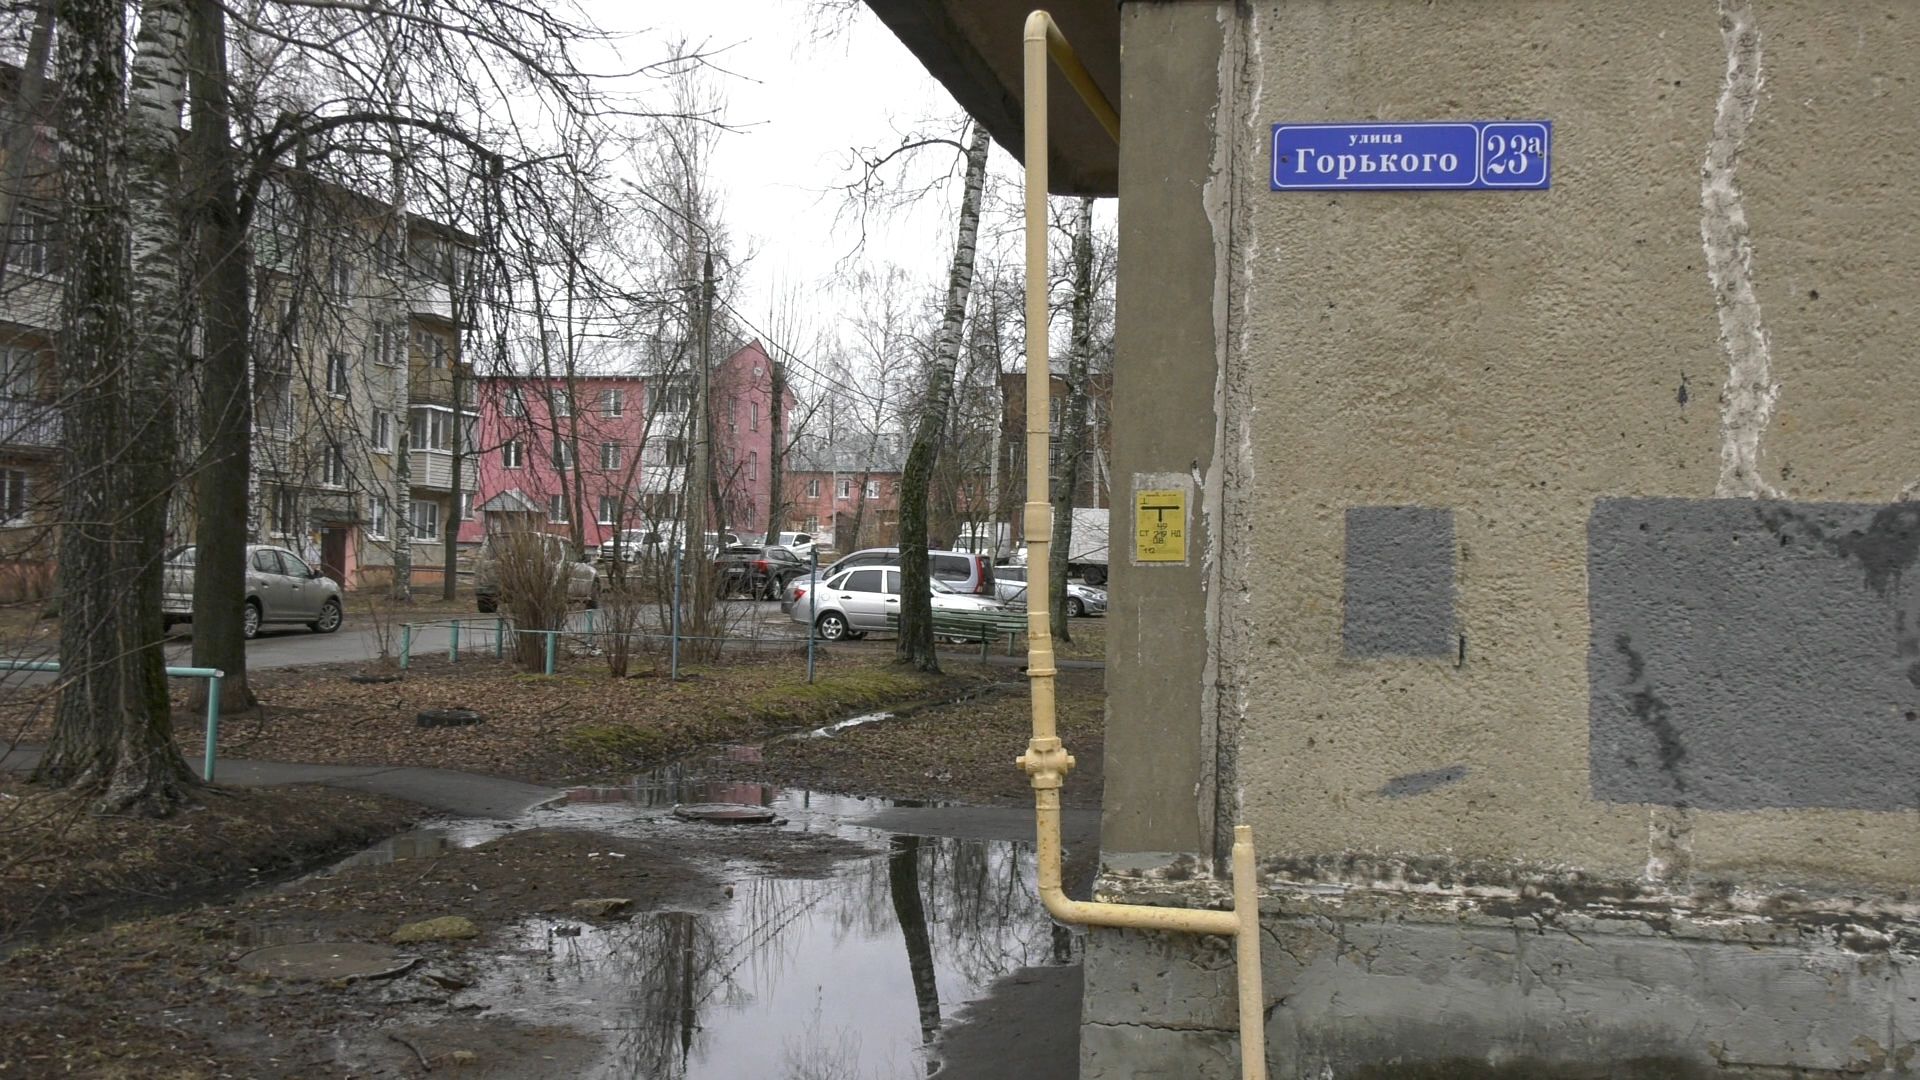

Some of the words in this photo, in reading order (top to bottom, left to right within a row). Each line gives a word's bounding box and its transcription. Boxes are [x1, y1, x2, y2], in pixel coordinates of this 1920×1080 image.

[1349, 133, 1403, 146] улица
[1295, 148, 1458, 180] Горького
[1486, 134, 1541, 174] 23а
